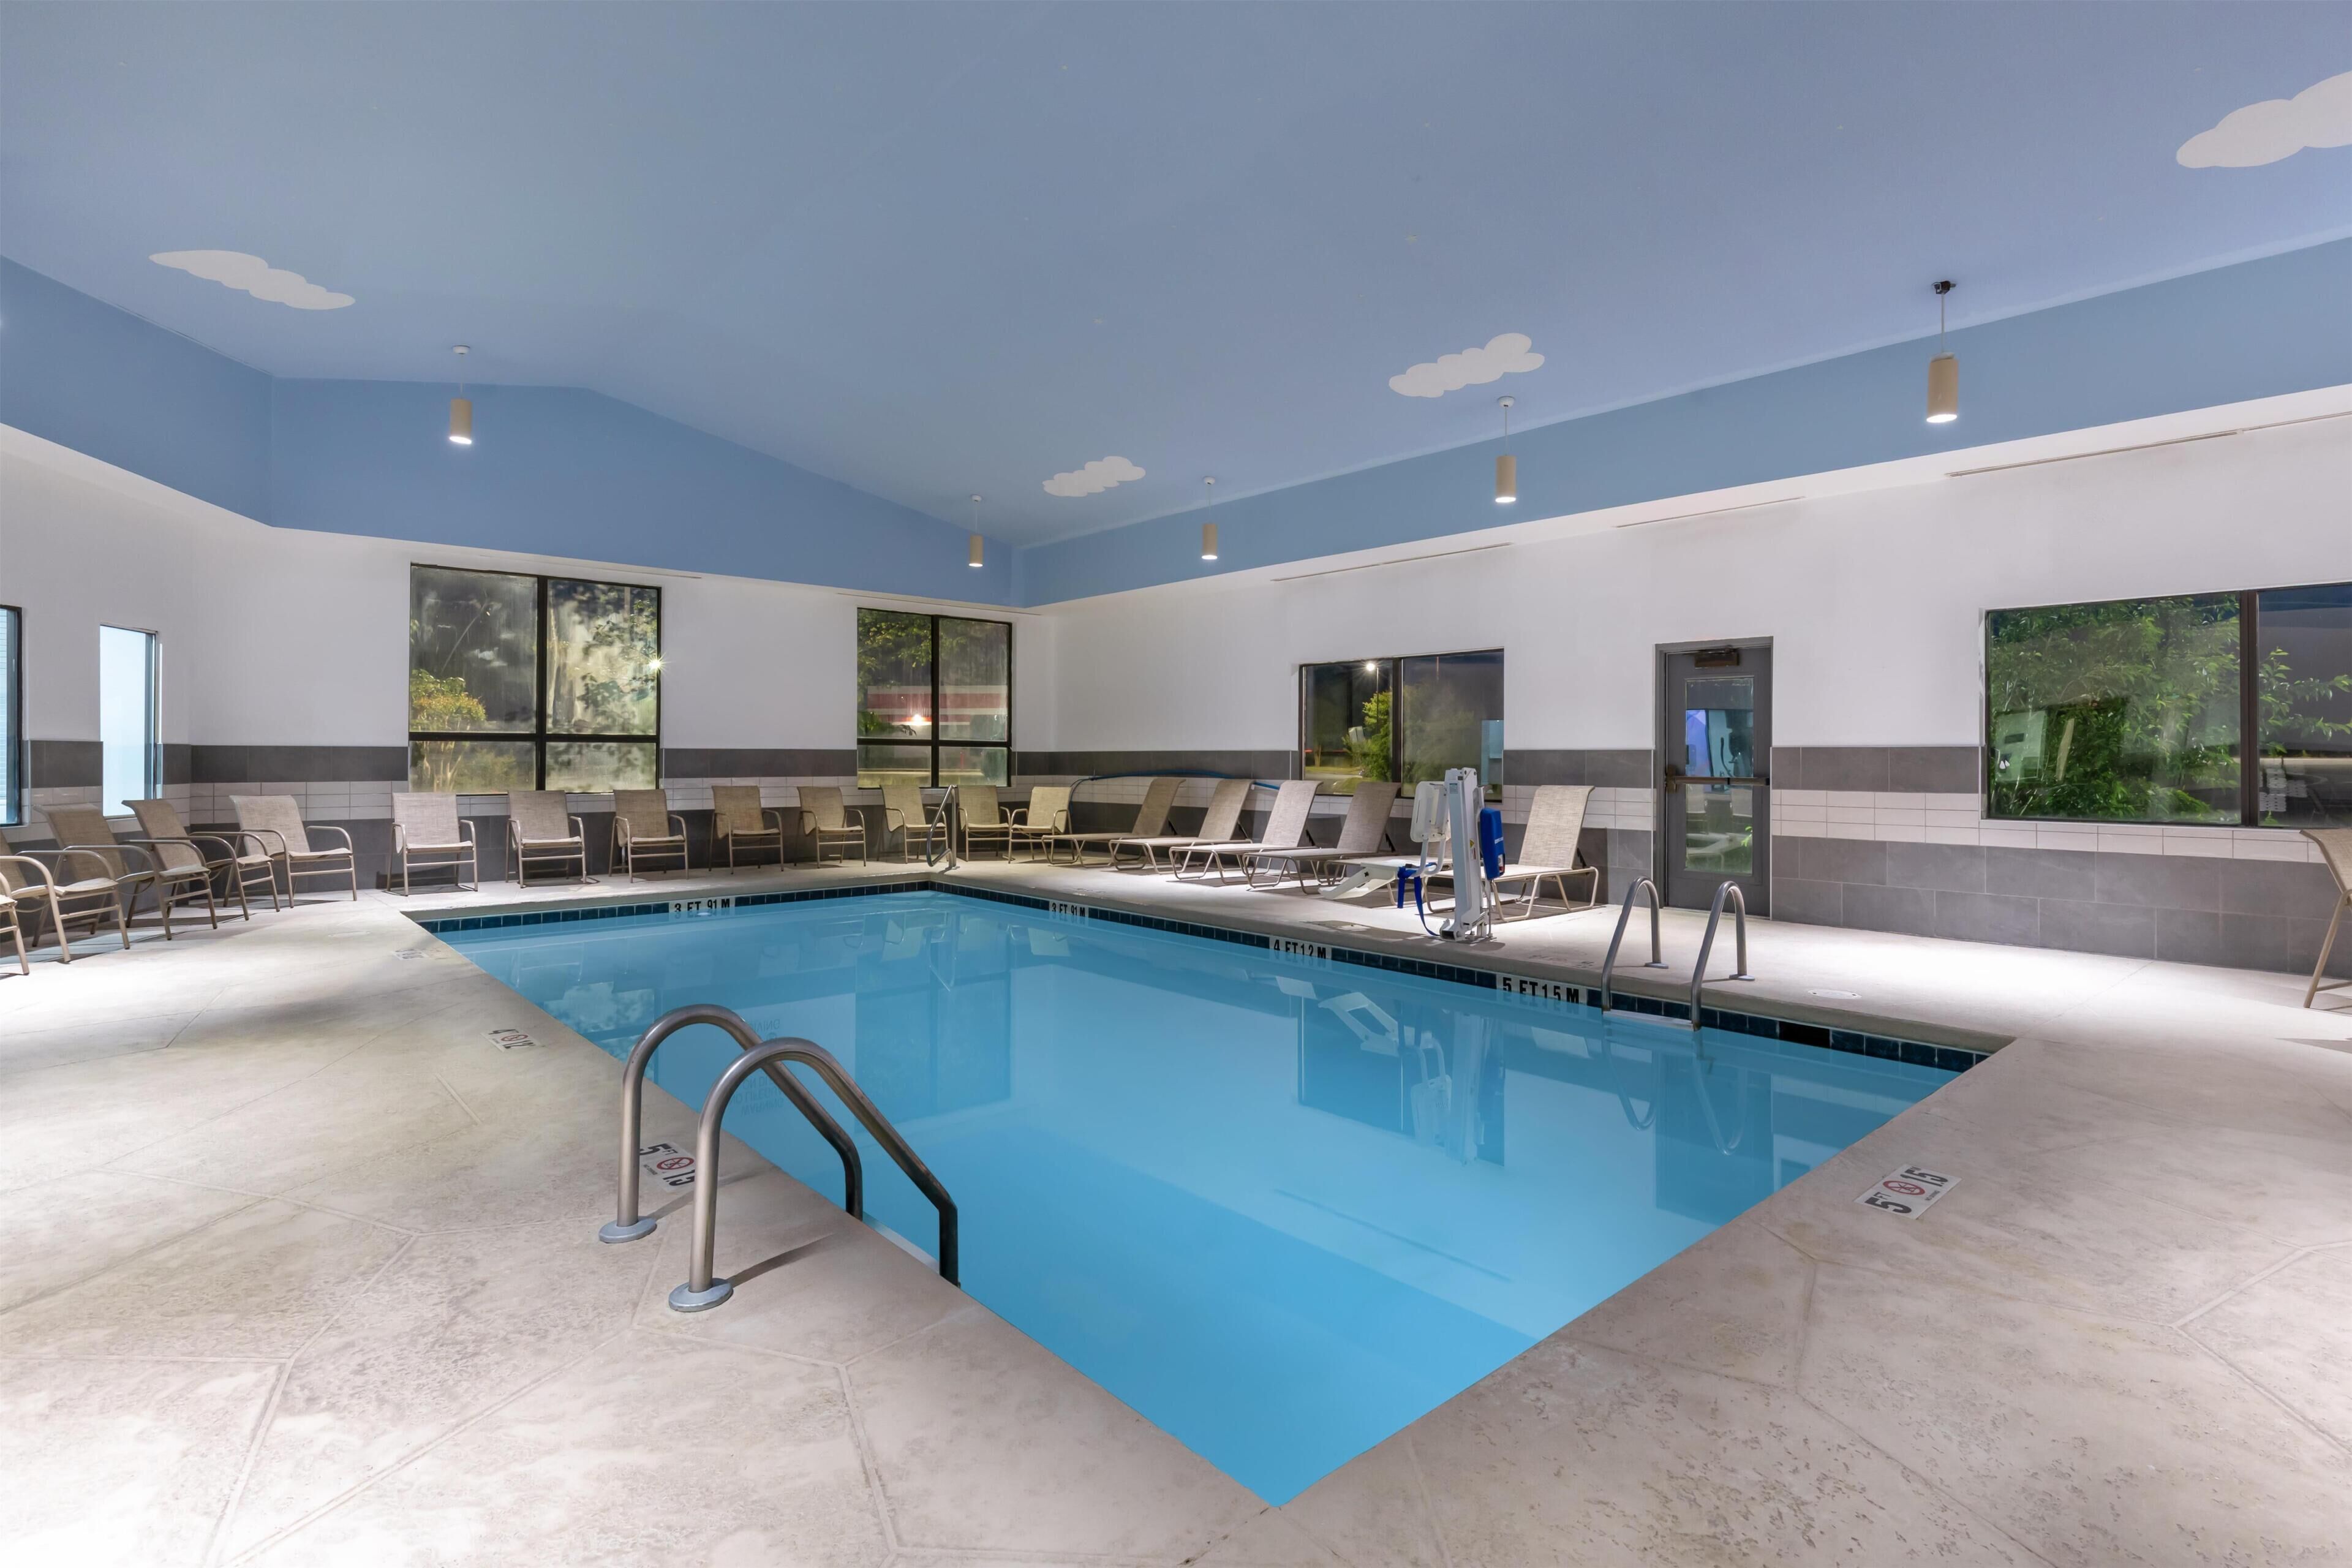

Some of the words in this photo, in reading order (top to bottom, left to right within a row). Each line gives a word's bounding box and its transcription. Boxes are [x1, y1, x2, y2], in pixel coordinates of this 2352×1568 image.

[674, 903, 681, 912] 3
[687, 901, 701, 911] FT
[722, 898, 730, 908] M
[1052, 902, 1057, 912] 3
[1060, 903, 1068, 914] FT
[1080, 907, 1085, 916] M
[1274, 939, 1280, 951] 4
[1286, 941, 1298, 954] FT
[1317, 946, 1326, 959] M
[1503, 976, 1512, 992] 5
[1520, 979, 1538, 997] FT
[1566, 987, 1579, 1005] M
[639, 1143, 673, 1156] 5
[1873, 1191, 1892, 1200] FT
[1864, 1197, 1912, 1214] 5
